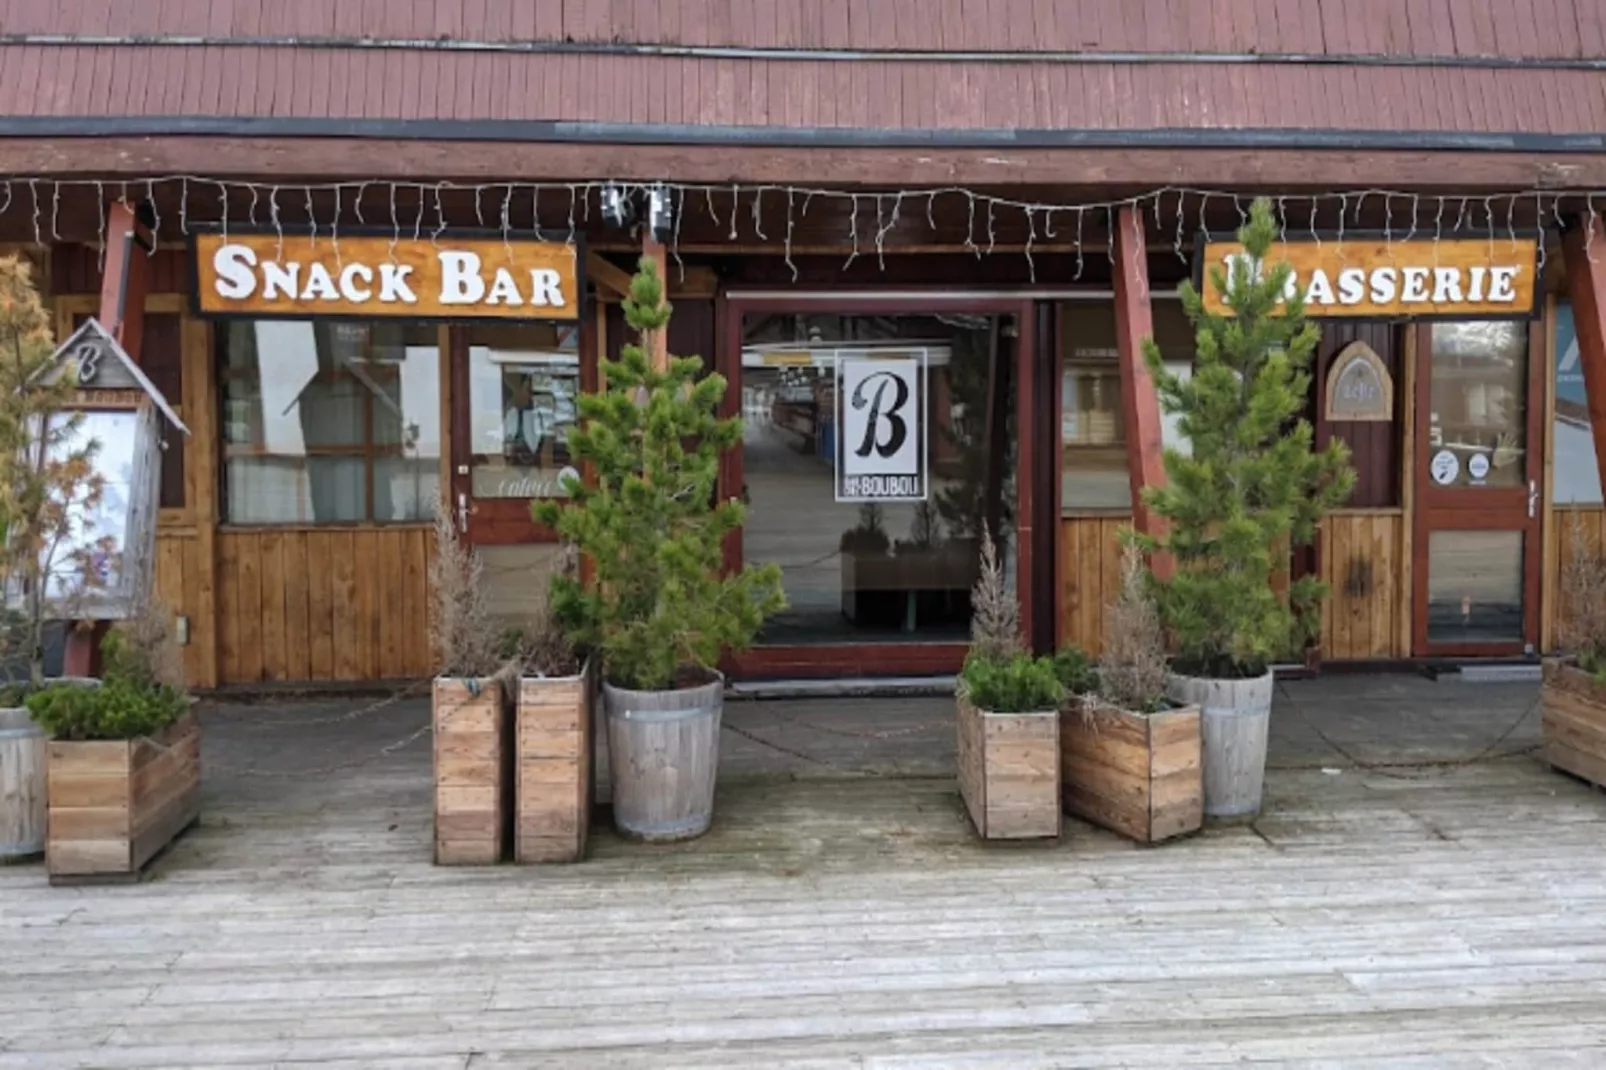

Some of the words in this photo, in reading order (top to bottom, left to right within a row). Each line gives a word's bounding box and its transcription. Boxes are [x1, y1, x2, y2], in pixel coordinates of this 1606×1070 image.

[213, 244, 417, 304] SNACK
[437, 251, 565, 307] BAR
[852, 371, 909, 459] B
